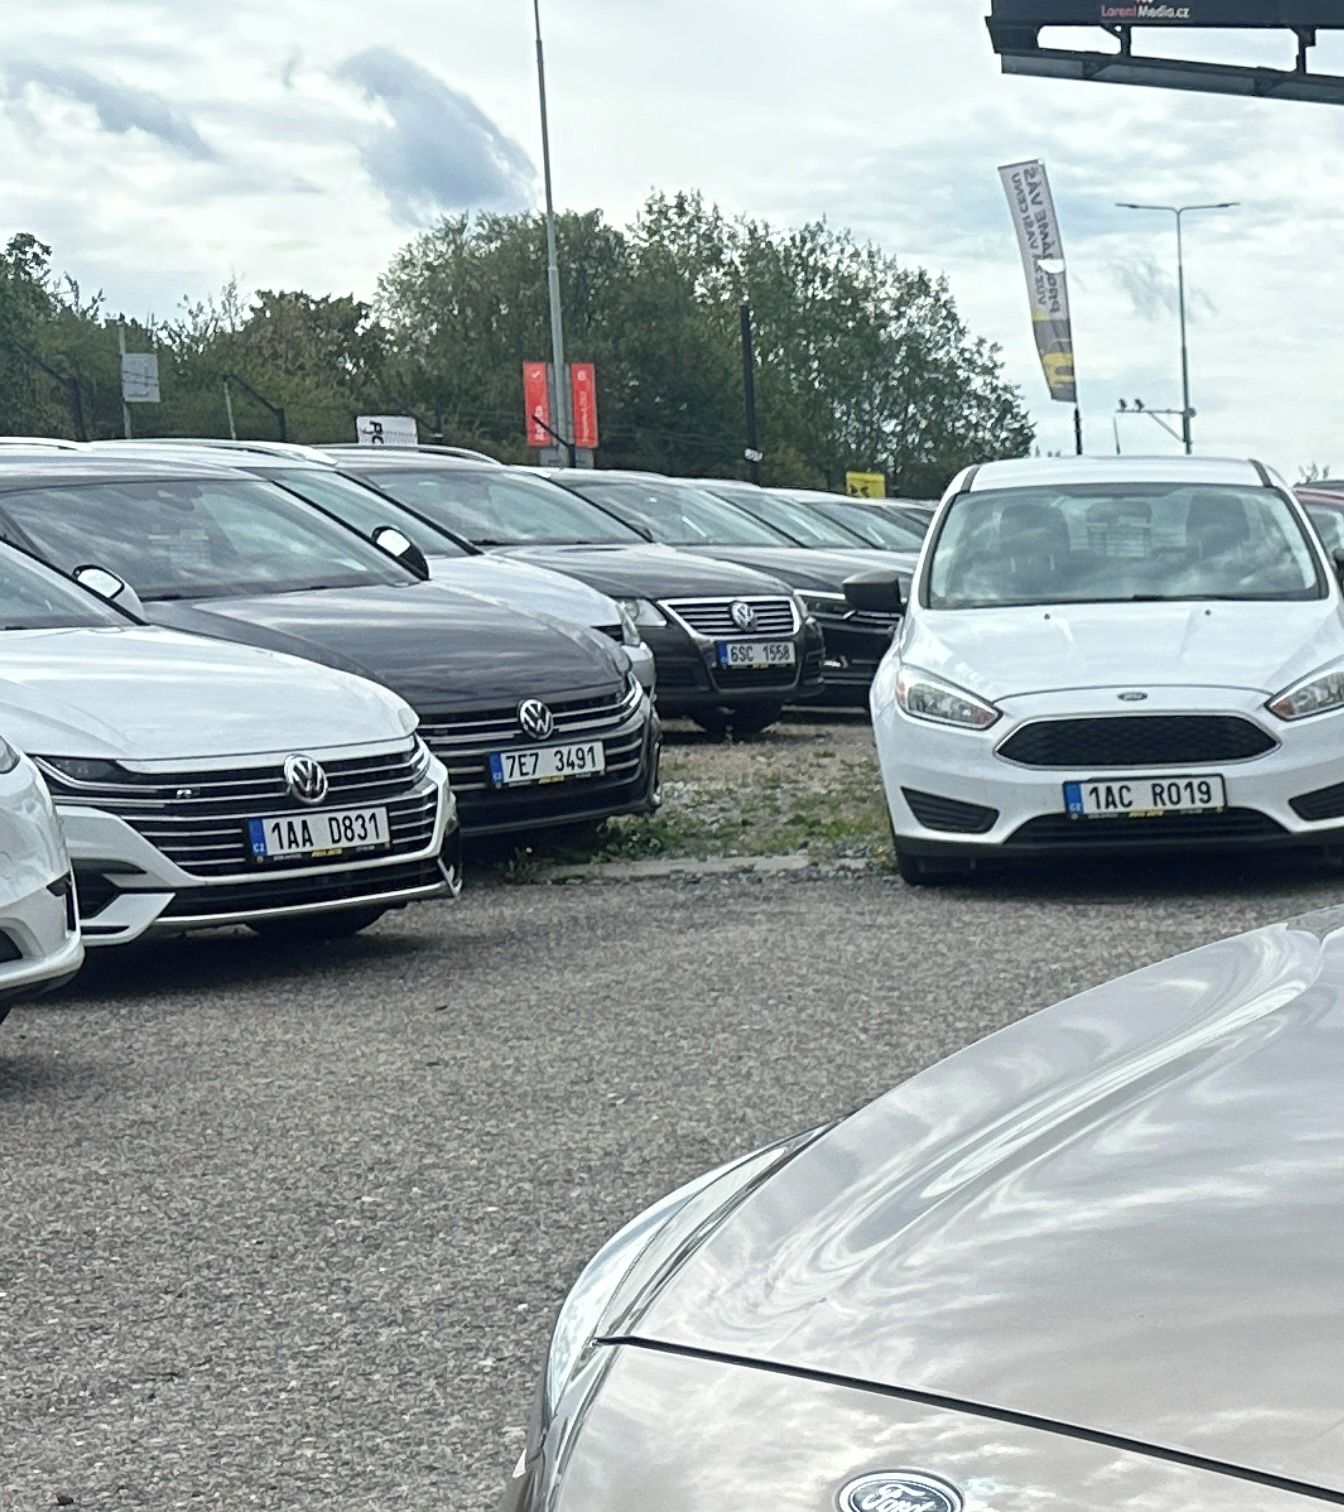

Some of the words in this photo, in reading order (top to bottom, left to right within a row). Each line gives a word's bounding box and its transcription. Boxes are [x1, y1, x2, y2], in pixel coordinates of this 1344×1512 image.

[730, 645, 754, 662] 6SC
[505, 752, 540, 779] 7E7
[553, 745, 597, 772] 3491
[1089, 785, 1134, 810] 1AC
[271, 820, 314, 850] 1AA
[328, 812, 380, 844] D831
